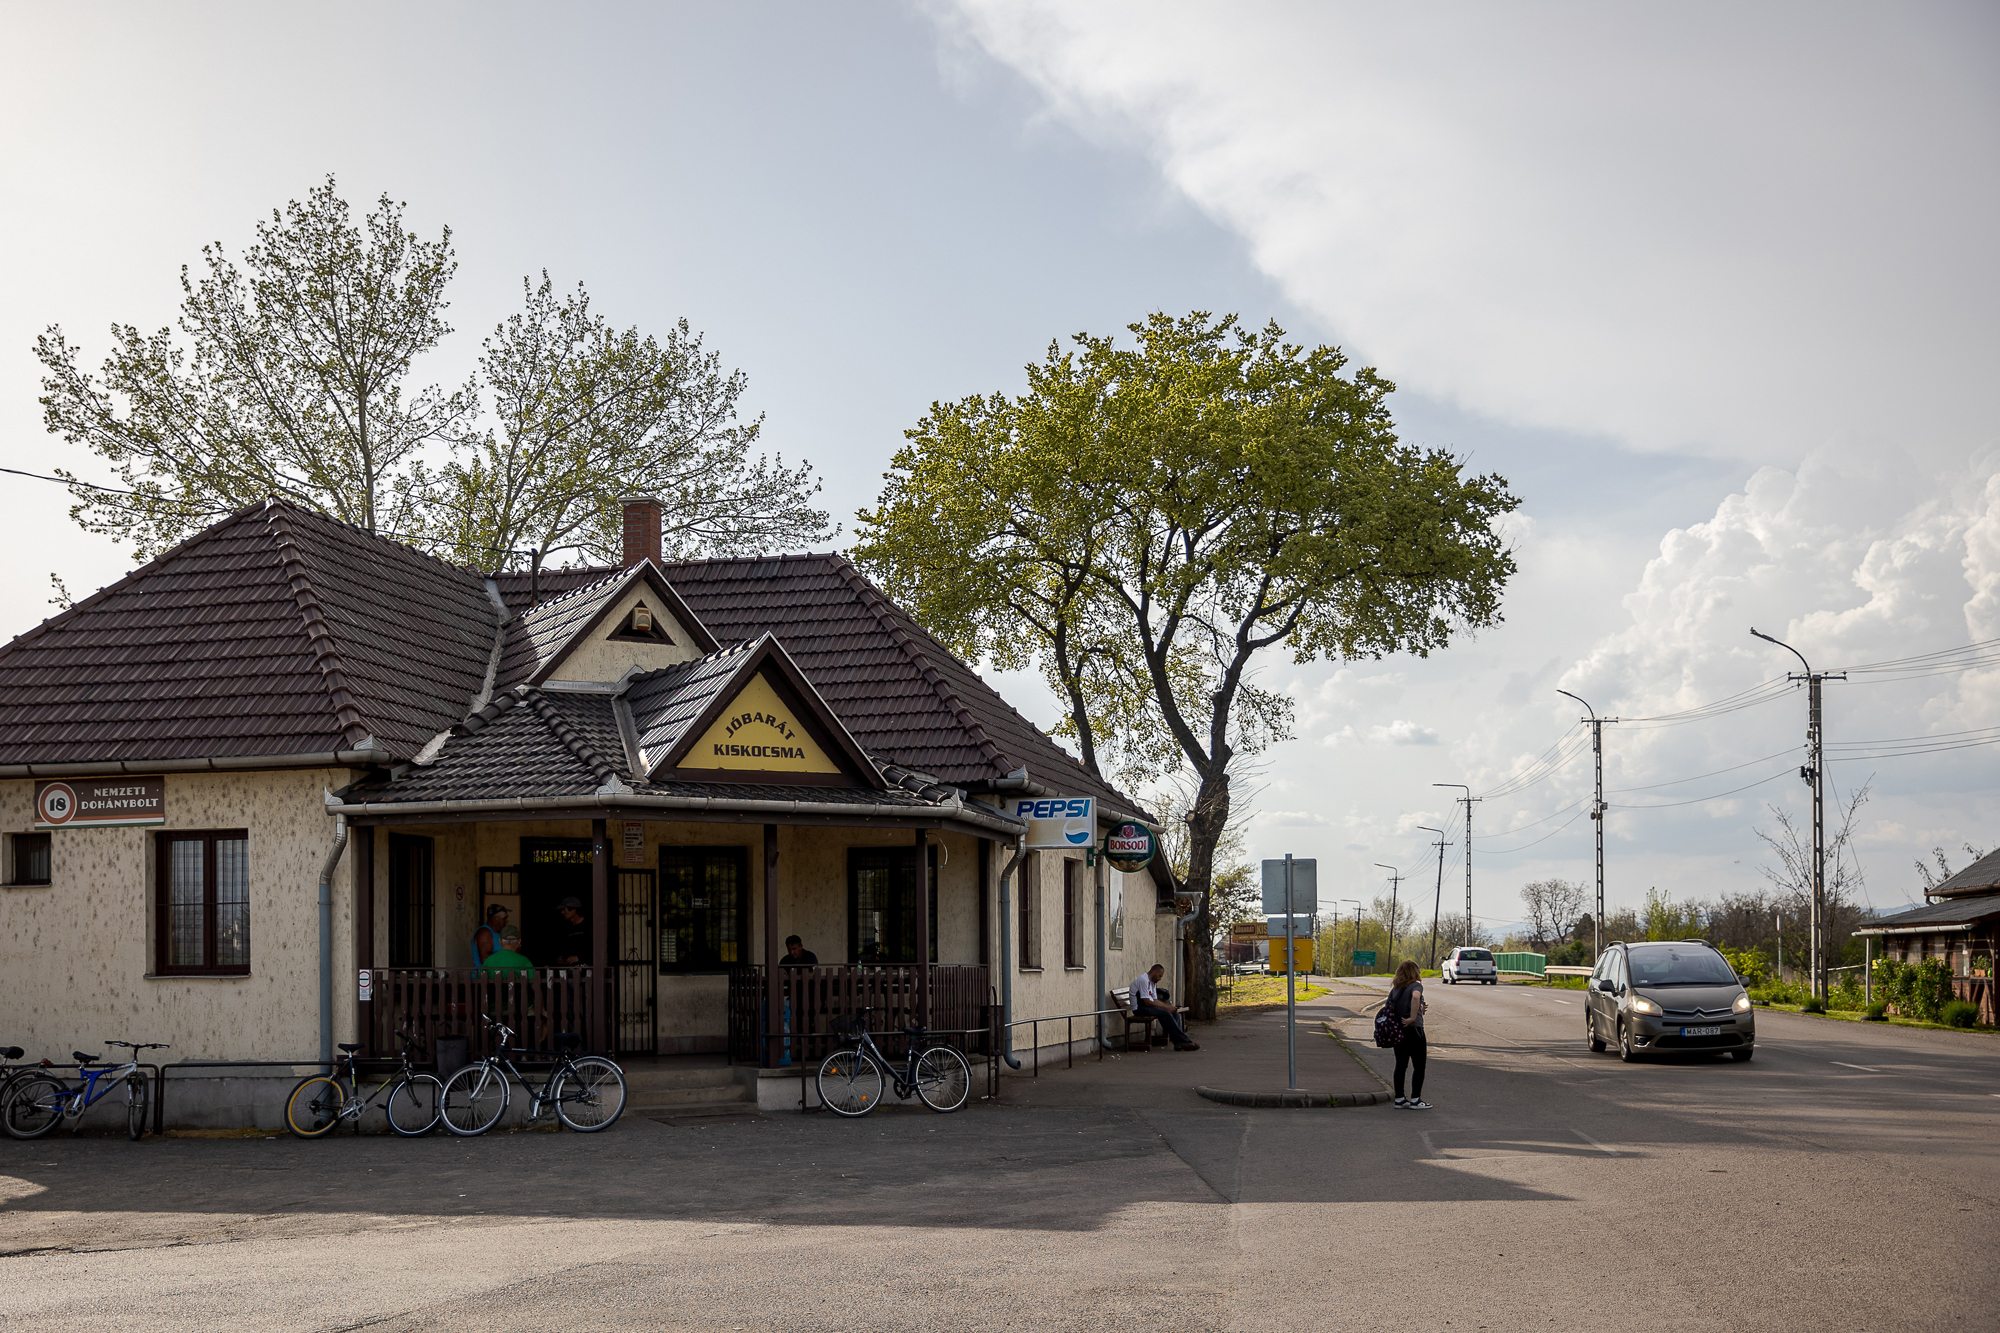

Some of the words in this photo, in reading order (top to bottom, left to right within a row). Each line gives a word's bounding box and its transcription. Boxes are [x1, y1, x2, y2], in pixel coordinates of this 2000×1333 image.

[725, 712, 796, 740] JÓBARÁT
[713, 744, 806, 759] KISKOCSMA
[94, 786, 146, 797] NEMZETI
[49, 797, 67, 812] 18
[81, 798, 159, 810] DOHÁNYBOLT
[1016, 799, 1091, 818] PEPSI
[1110, 839, 1147, 850] BORSODI
